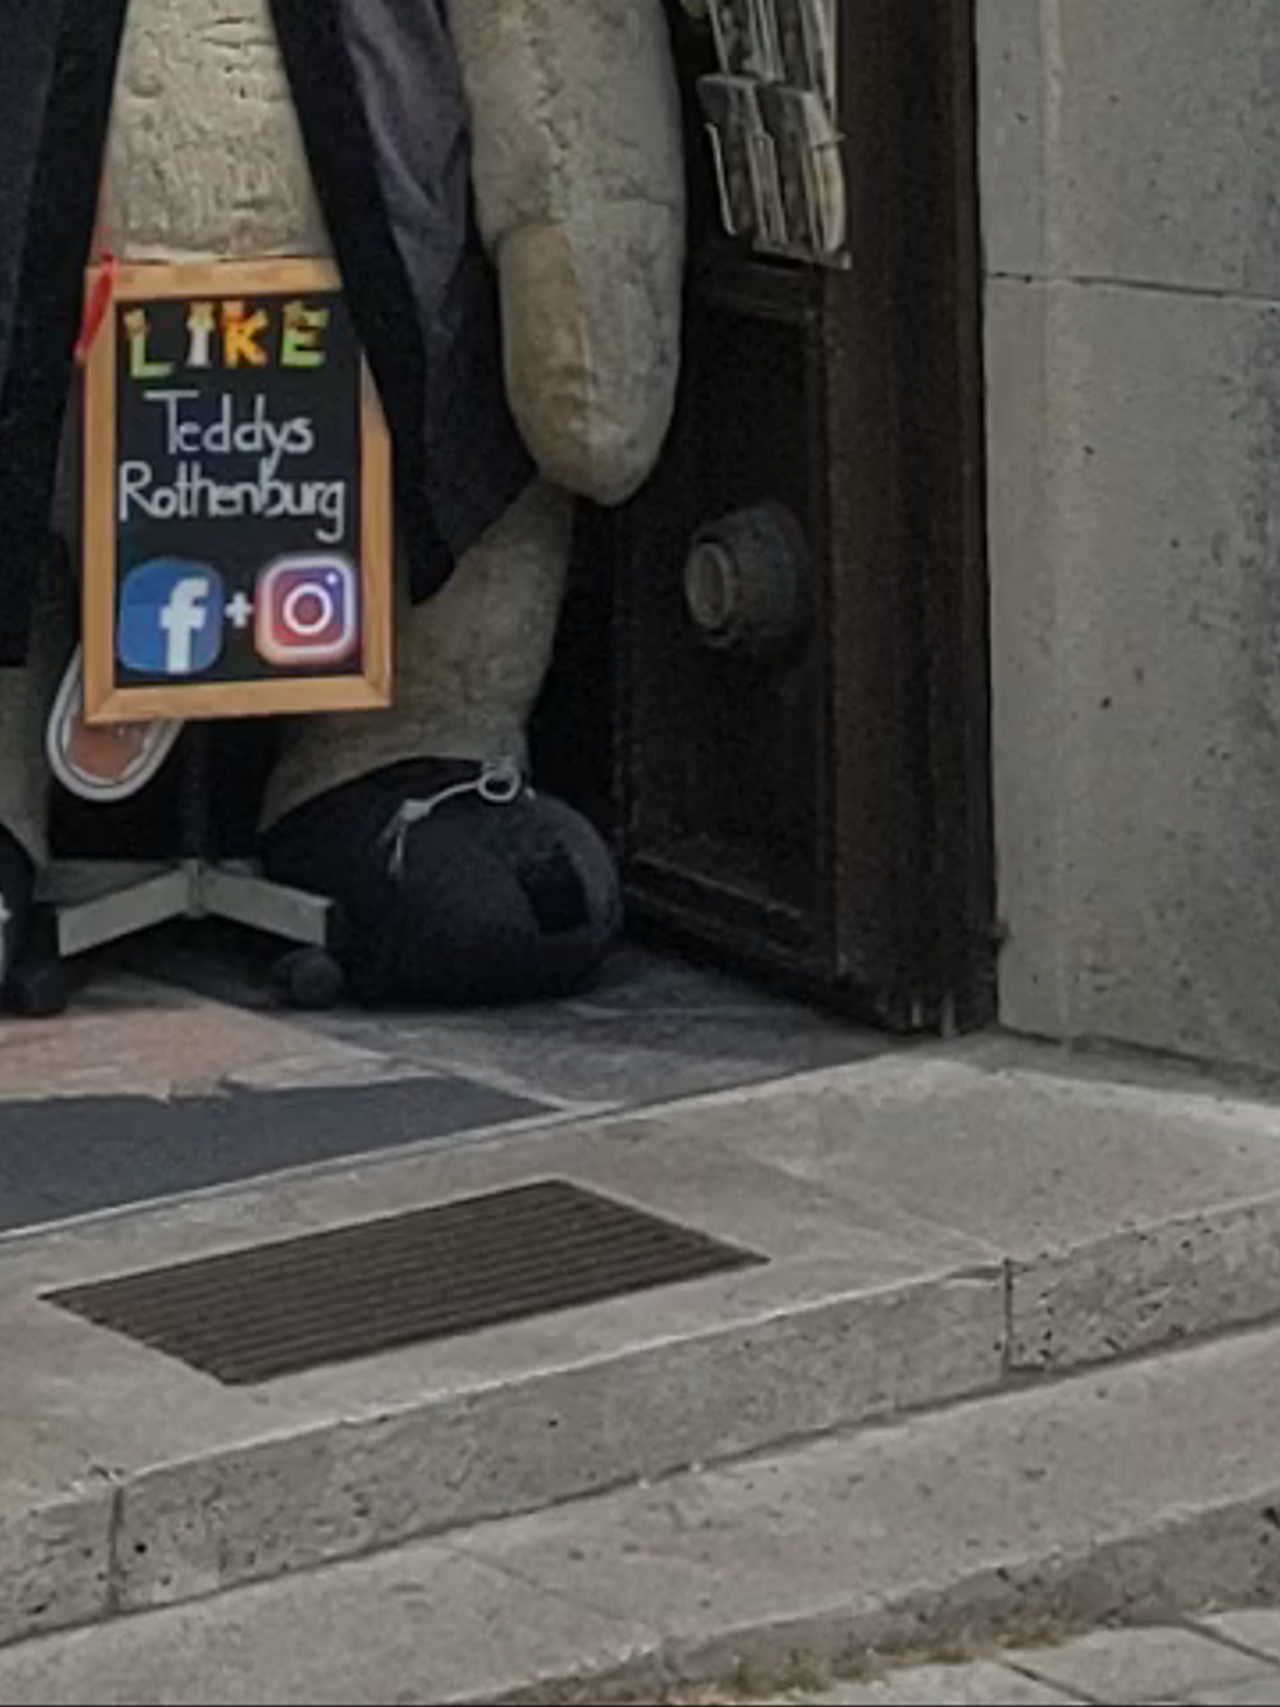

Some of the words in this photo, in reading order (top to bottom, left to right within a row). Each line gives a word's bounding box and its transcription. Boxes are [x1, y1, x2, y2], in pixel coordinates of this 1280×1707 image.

[124, 300, 329, 378] LIKE
[143, 389, 315, 477] Teddys
[119, 457, 346, 544] Rothenburg
